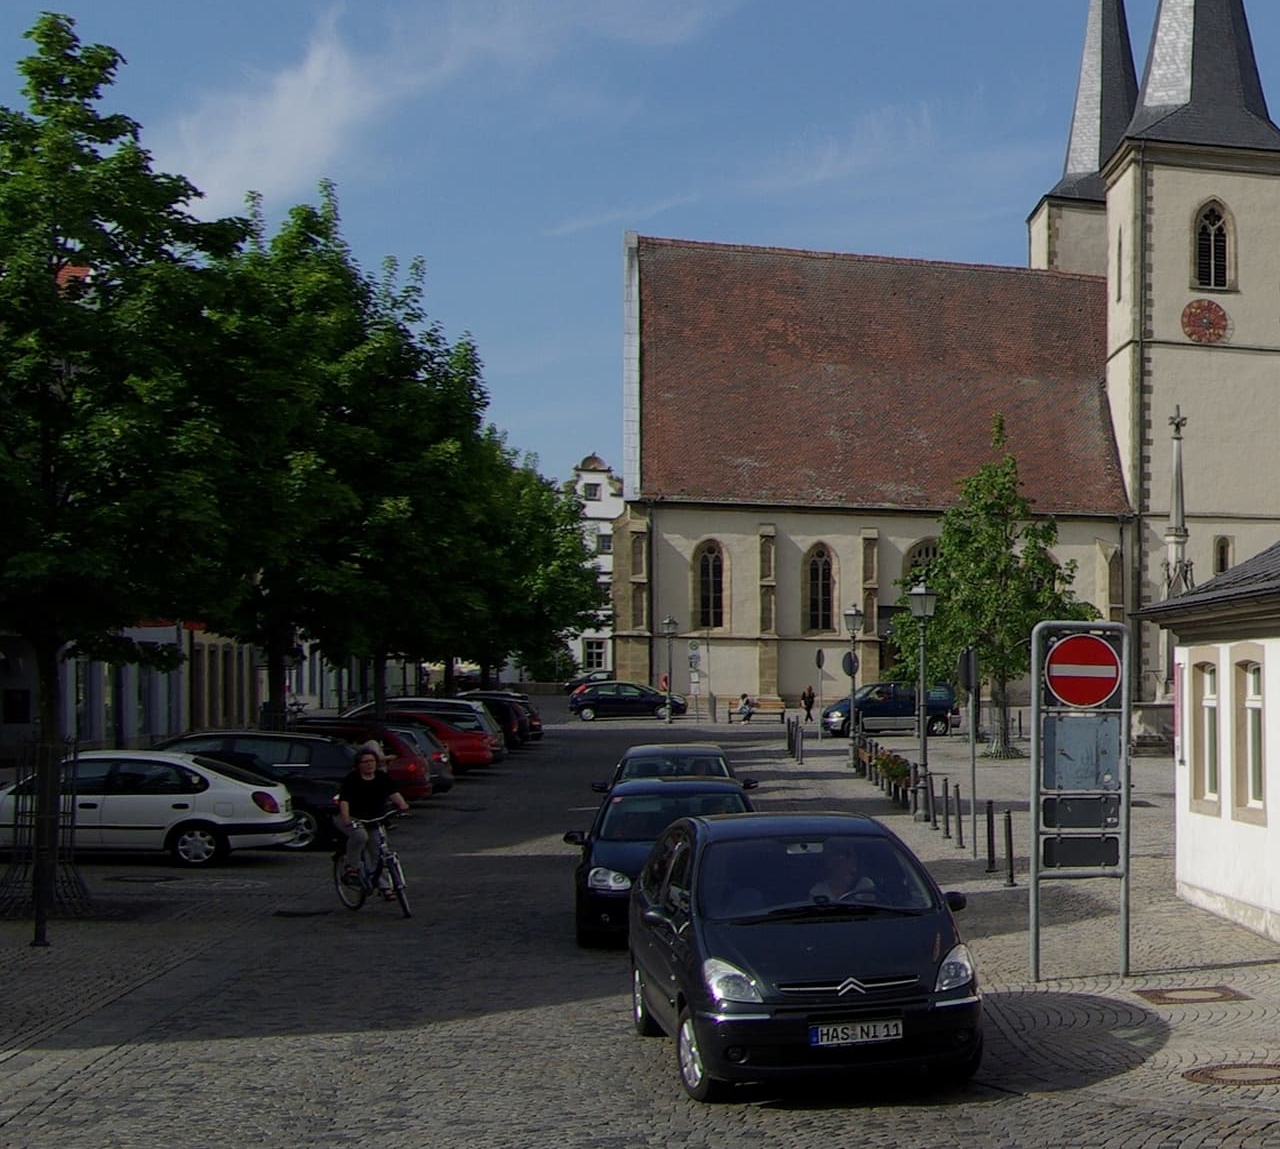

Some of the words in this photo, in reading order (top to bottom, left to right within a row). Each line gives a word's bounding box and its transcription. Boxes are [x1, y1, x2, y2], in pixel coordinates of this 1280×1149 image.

[820, 1026, 850, 1042] HAS
[860, 1024, 878, 1039] NI
[883, 1022, 899, 1037] 11
